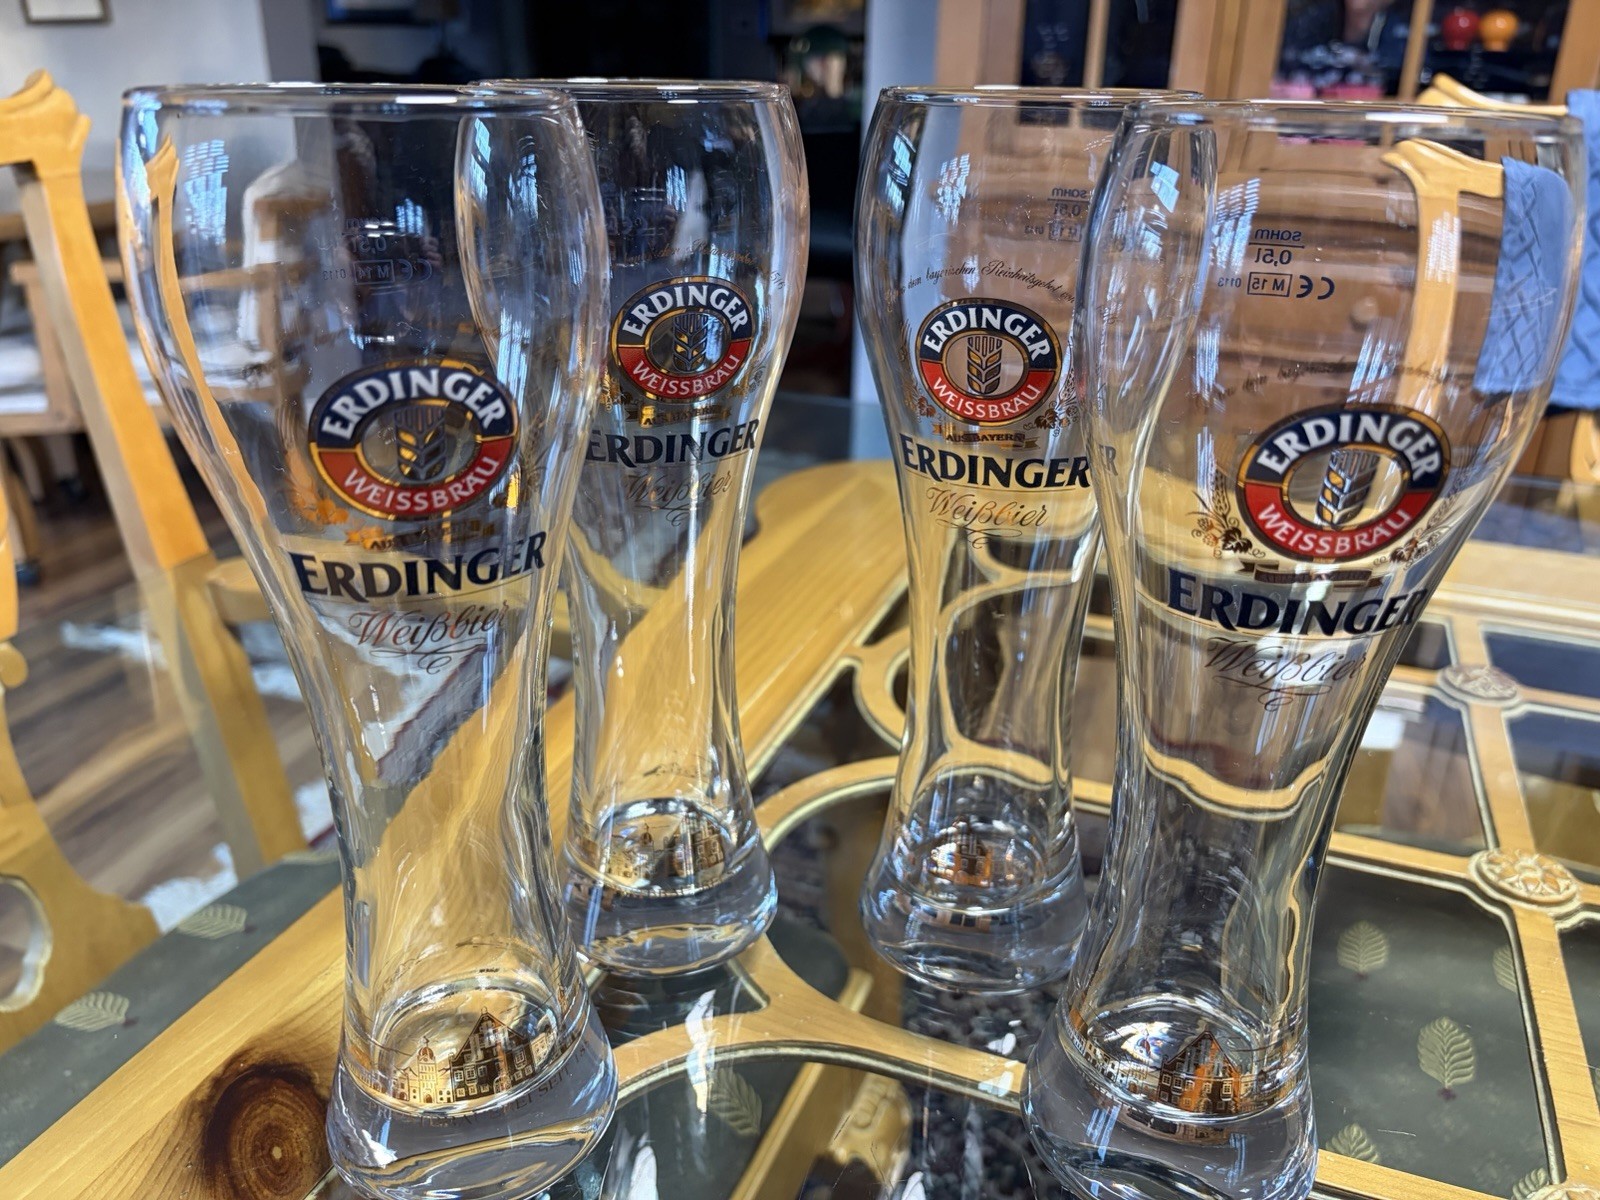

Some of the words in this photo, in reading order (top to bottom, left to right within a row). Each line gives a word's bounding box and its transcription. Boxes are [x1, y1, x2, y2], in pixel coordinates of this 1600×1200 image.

[981, 260, 1063, 290] Reinheitsgebot
[622, 284, 749, 337] ERDINGER
[922, 307, 1051, 362] ERDINGER
[632, 355, 740, 396] WEISSBRÄU
[932, 376, 1042, 419] WEISSBRÄU
[321, 368, 507, 441] ERDINGER
[585, 419, 760, 468] ERDINGER
[899, 433, 1091, 488] ERDINGER
[1256, 413, 1442, 482] ERDINGER
[344, 456, 500, 512] WEISSBRÄU
[926, 486, 1050, 528] Weißbier
[1257, 503, 1413, 556] WEISSBRÄU
[289, 531, 547, 603] ERDINGER
[349, 601, 509, 647] Weißbier
[1168, 567, 1428, 636] ERDINGER
[1204, 637, 1367, 684] Weißbier
